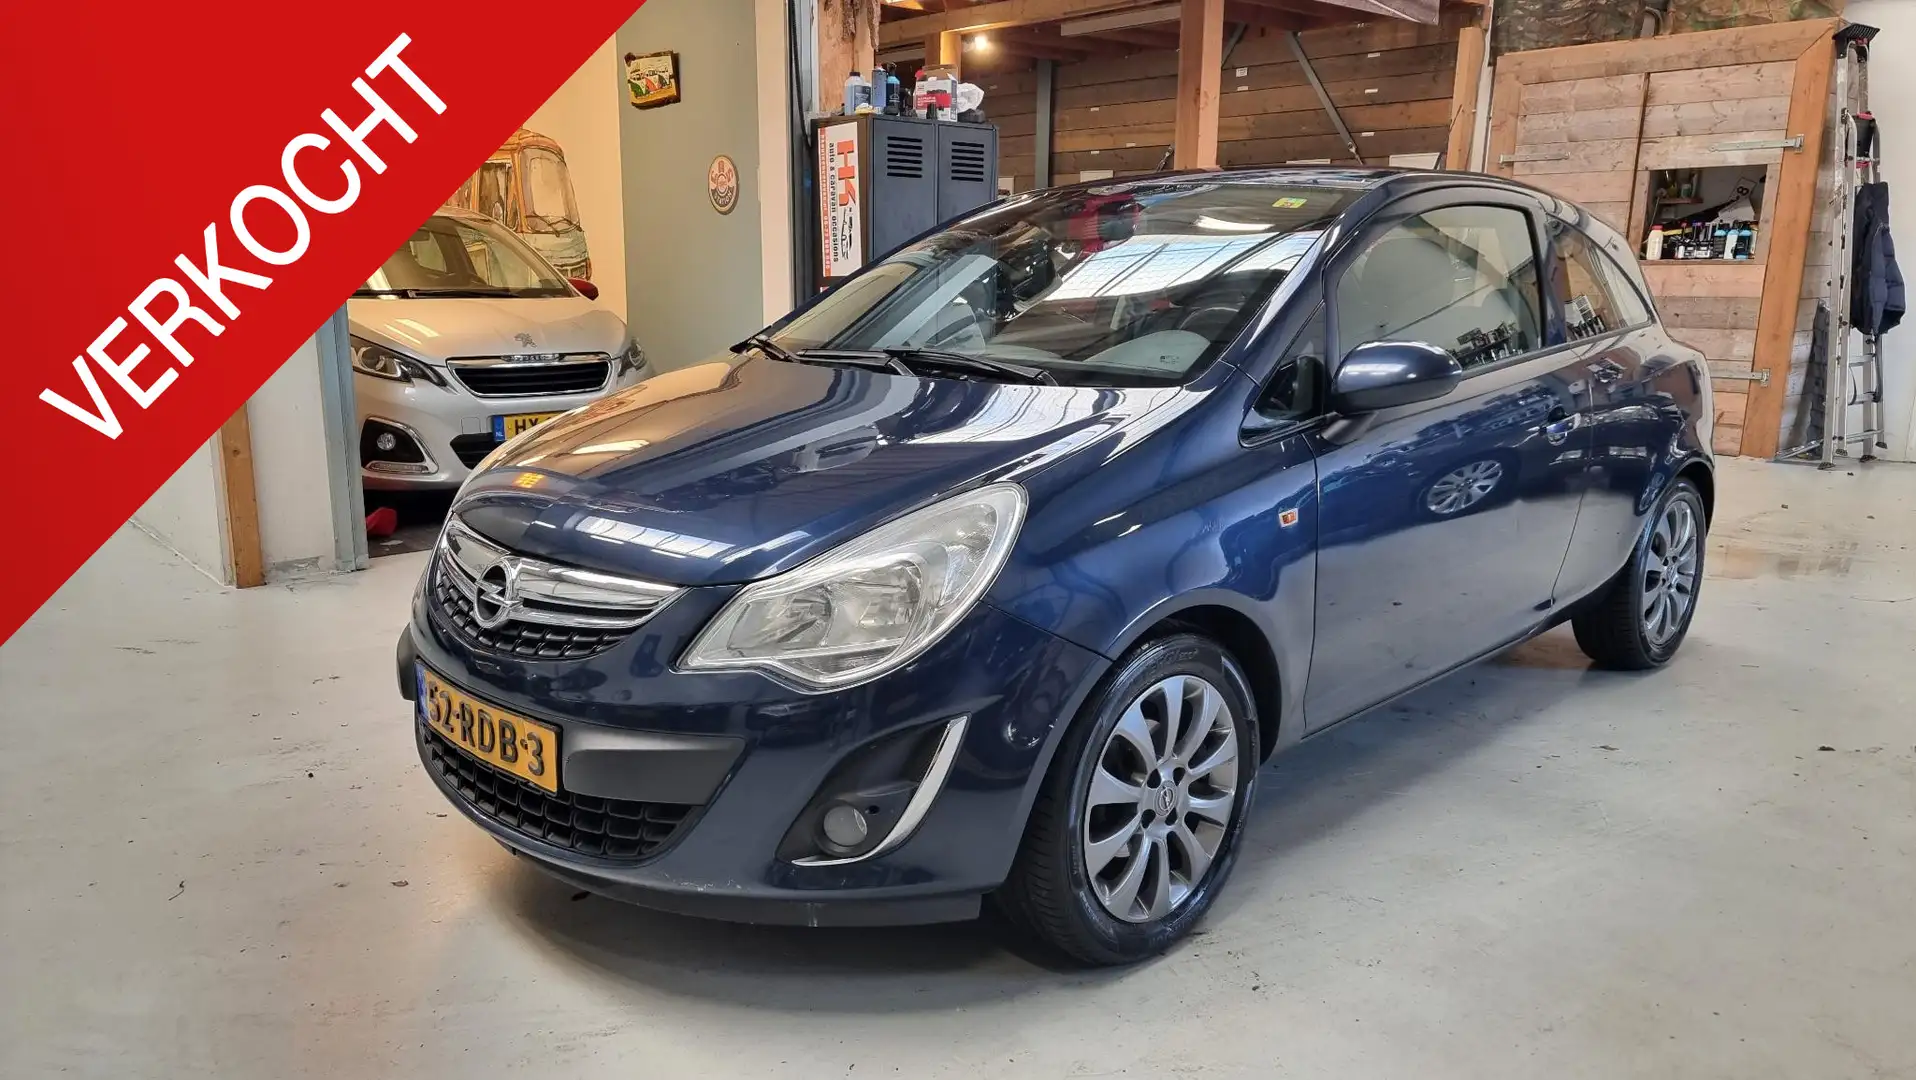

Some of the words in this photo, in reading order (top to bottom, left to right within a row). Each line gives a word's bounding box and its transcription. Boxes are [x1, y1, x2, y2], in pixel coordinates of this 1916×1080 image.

[837, 140, 856, 207] HK
[831, 215, 839, 263] occasions
[427, 680, 544, 777] 52-RDB-3
